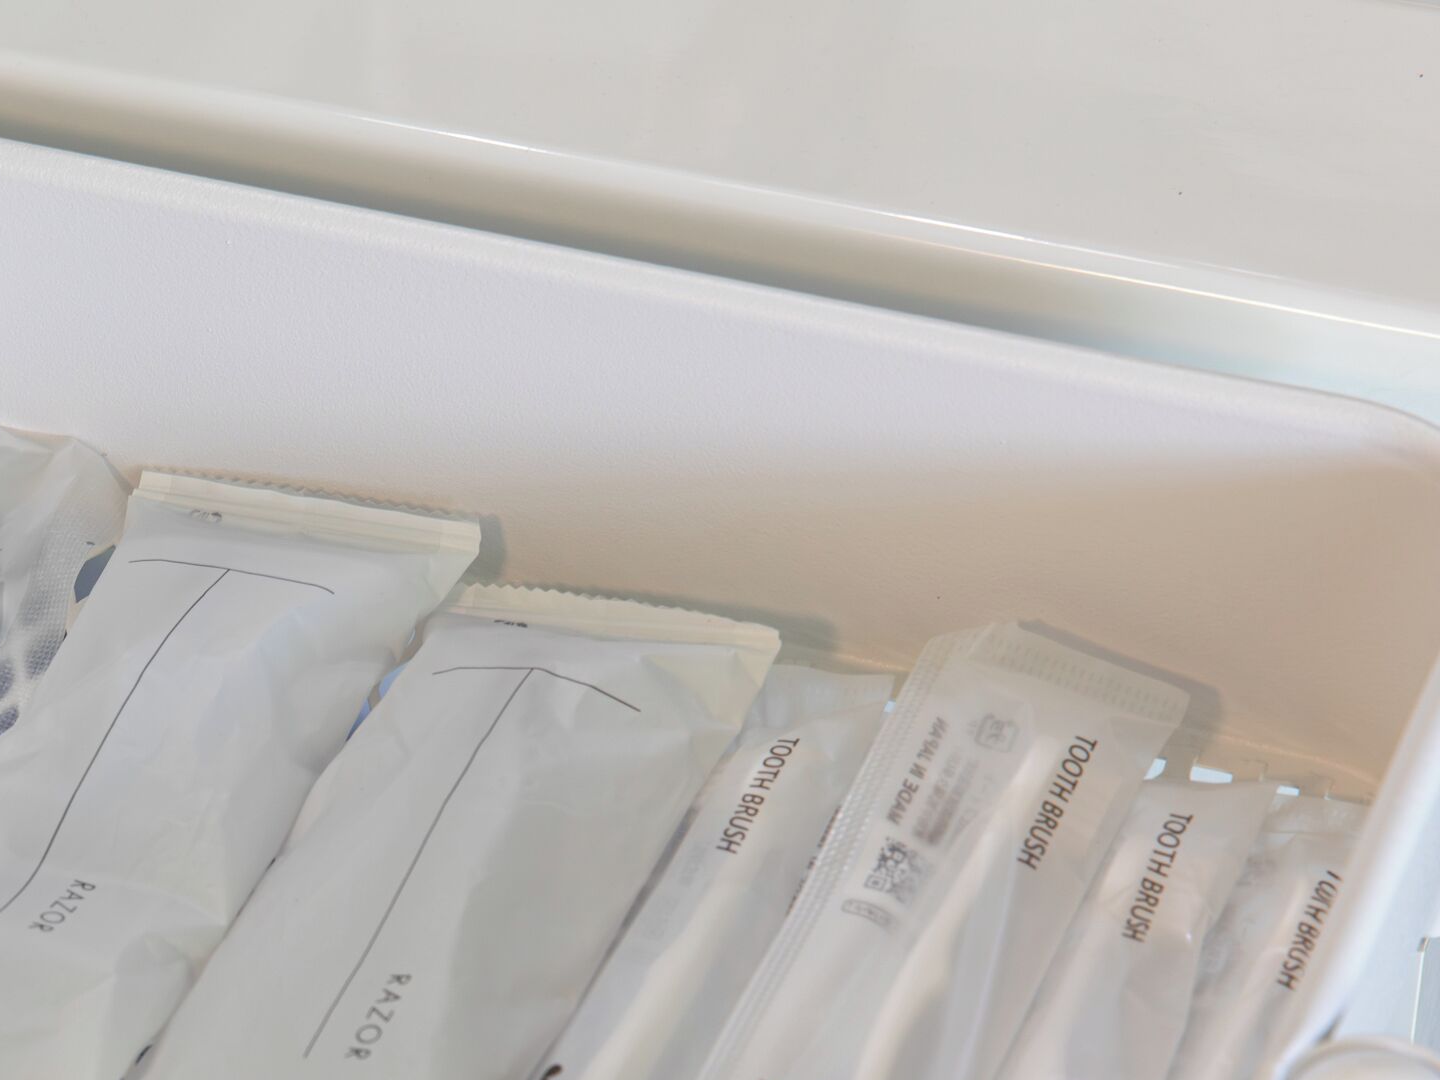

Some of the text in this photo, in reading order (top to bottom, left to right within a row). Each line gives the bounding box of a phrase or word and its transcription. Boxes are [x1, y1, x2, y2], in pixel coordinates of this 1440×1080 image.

[716, 738, 800, 855] TOOTH BRUSH
[1017, 735, 1098, 871] TOOTH BRUSH
[29, 879, 96, 934] RAZOR
[1122, 812, 1193, 944] TOOTH BRUSH
[1277, 921, 1321, 990] BRUSH
[345, 973, 412, 1061] RAZOR
